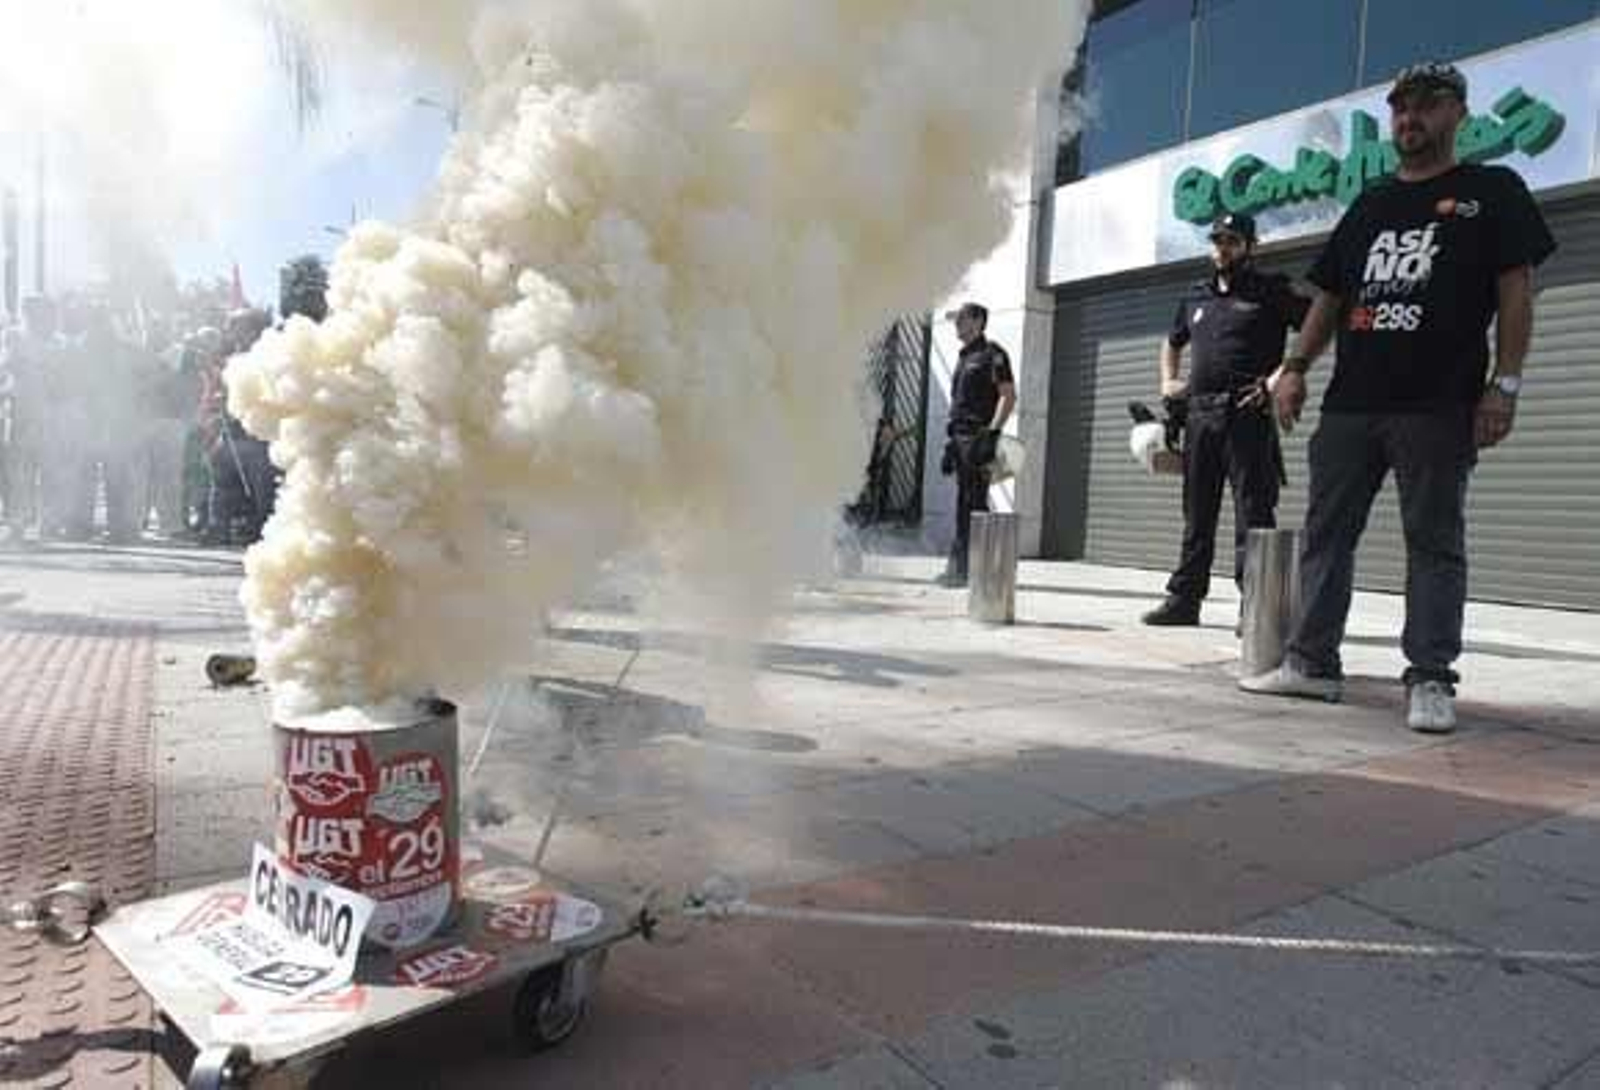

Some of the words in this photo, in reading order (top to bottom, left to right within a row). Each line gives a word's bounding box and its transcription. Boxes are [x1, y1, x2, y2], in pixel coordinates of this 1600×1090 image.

[1218, 148, 1341, 214] Corte
[1372, 302, 1423, 331] 29S
[290, 736, 357, 776] UGT
[379, 757, 434, 793] UGT
[294, 814, 364, 859] UGT
[388, 820, 444, 879] 29
[254, 860, 354, 958] CERADO
